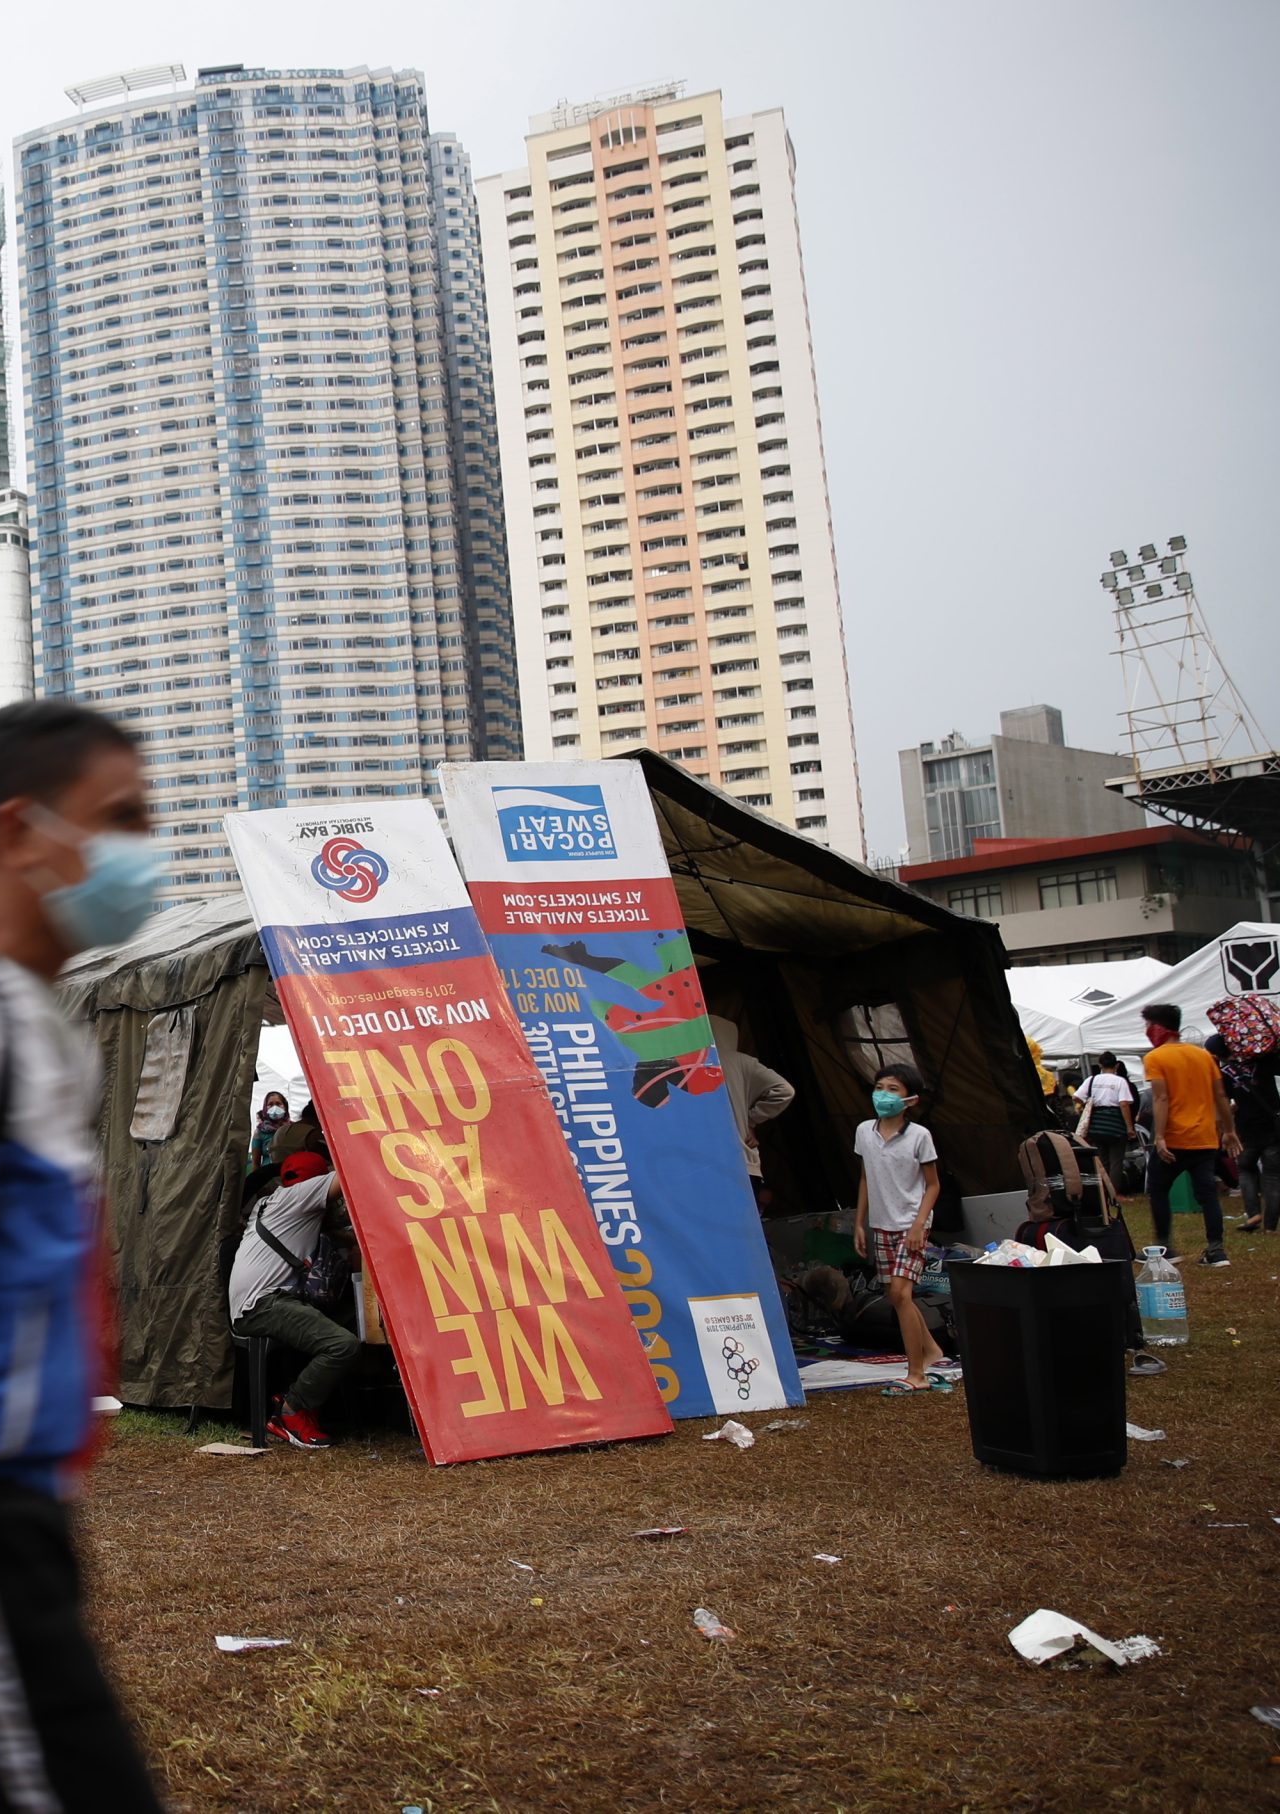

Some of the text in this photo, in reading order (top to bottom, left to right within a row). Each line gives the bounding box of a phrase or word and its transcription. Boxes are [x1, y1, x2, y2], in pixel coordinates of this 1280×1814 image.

[231, 68, 282, 81] GRAND
[286, 68, 344, 79] TOWERS
[296, 816, 372, 828] METROPOLITAN AUTHORITY
[299, 821, 375, 838] SUBIC BAY
[517, 814, 609, 832] SWEAT
[510, 831, 614, 851] POCARI
[502, 891, 642, 907] AT SMTICKETS.COM
[504, 908, 650, 925] TICKETS AVAILABLE
[296, 921, 450, 950] AT SMTICKETS.COM
[299, 937, 461, 967] TICKETS AVAILABLE
[499, 967, 587, 989] TO DEC 11
[326, 982, 457, 1006] 2019seagames.com
[516, 991, 581, 1014] NOV 30
[311, 997, 491, 1038] NOV 30 TO DEC 11
[323, 1038, 492, 1136] ONE
[552, 1023, 642, 1246] PHILIPPINES
[379, 1124, 488, 1220] AS
[405, 1207, 606, 1318] WIN
[706, 1323, 756, 1333] PHILIPPINES 2019
[710, 1316, 731, 1324] GAMES
[730, 1314, 745, 1323] SEA
[434, 1304, 604, 1419] WE
